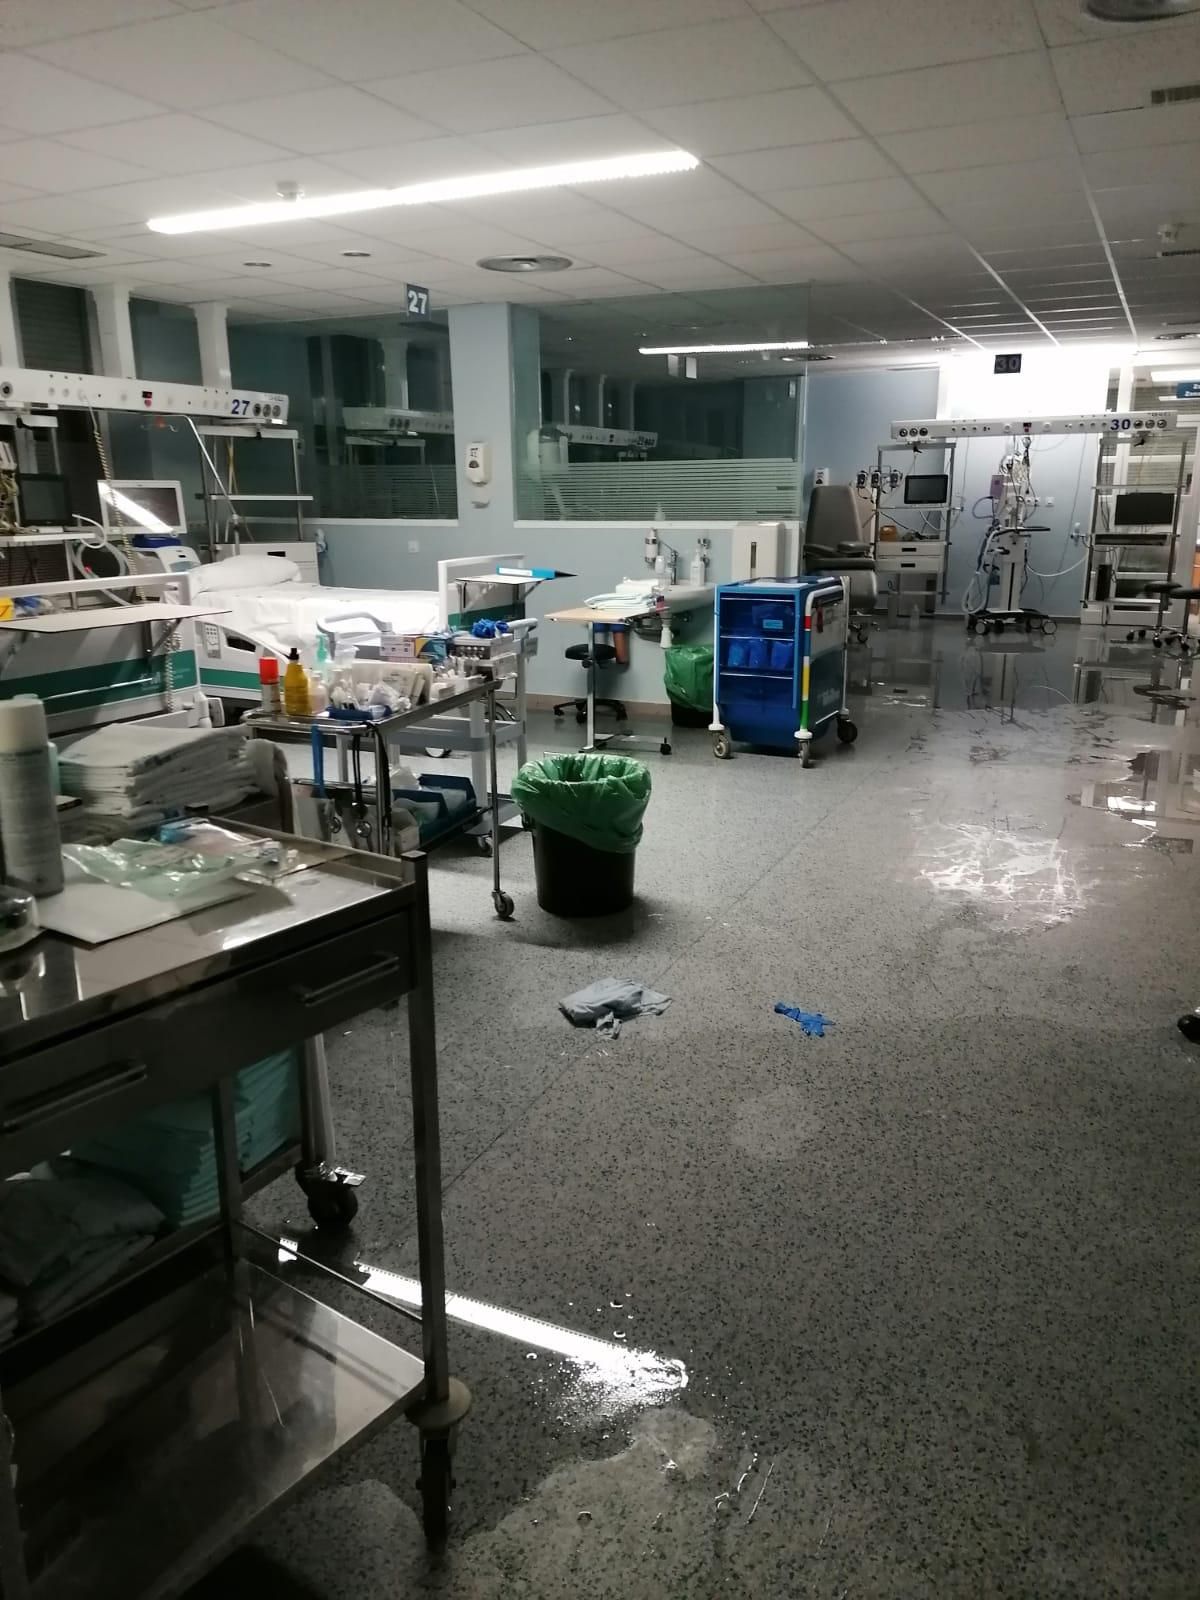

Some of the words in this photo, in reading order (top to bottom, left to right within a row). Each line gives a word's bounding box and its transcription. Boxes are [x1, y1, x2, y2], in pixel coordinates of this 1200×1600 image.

[408, 290, 427, 314] 27
[996, 358, 1020, 370] 30
[231, 399, 250, 416] 27
[1110, 419, 1131, 430] 30
